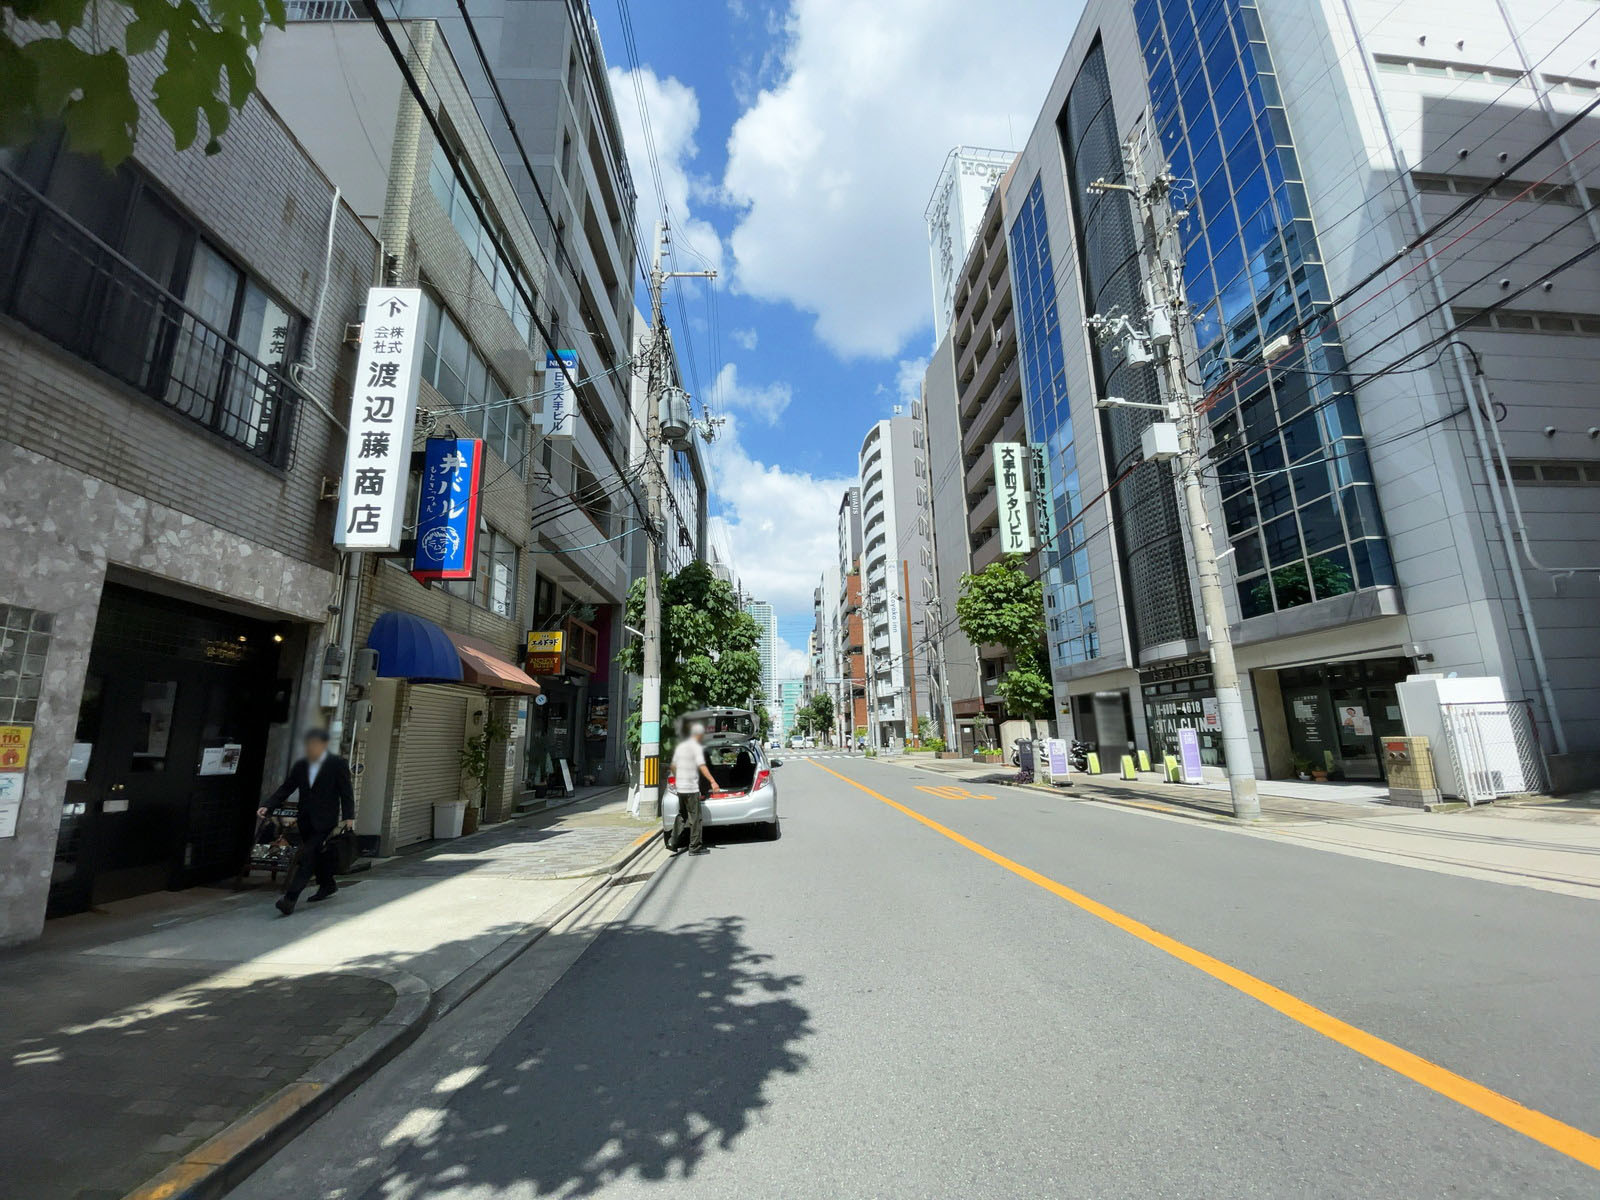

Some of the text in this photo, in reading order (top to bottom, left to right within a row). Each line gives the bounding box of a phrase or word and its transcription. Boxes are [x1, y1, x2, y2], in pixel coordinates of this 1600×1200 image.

[346, 361, 400, 534] 渡辺藤商店
[1001, 447, 1023, 549] 大手前フタバビル
[2, 734, 20, 744] 110
